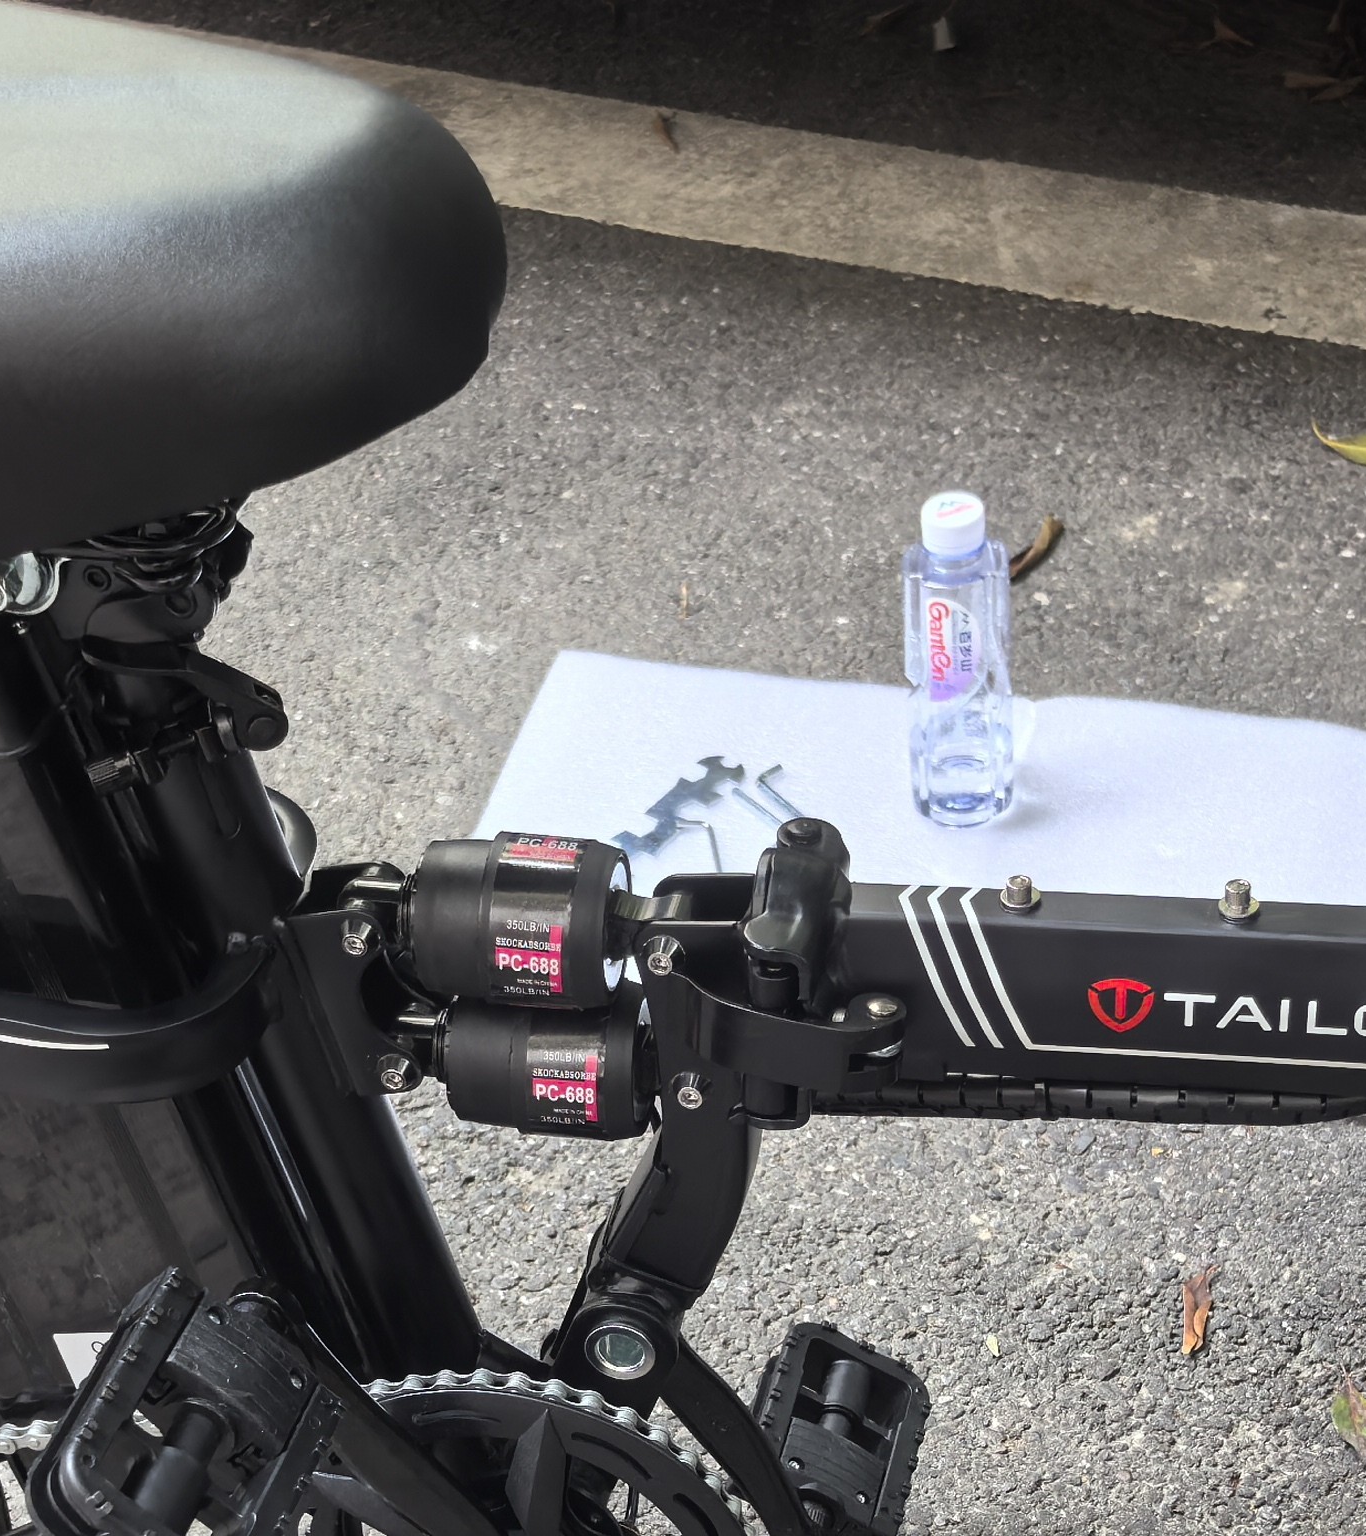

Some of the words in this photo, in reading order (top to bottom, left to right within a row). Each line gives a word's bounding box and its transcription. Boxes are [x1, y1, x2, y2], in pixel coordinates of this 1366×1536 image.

[959, 631, 973, 672] 百岁山
[517, 837, 578, 850] PC-688
[506, 919, 550, 933] 350LB/IN
[498, 953, 559, 975] PC-688
[504, 986, 550, 996] 350LB/IN
[543, 1051, 586, 1062] 350LB/IN
[535, 1083, 594, 1104] PC-688
